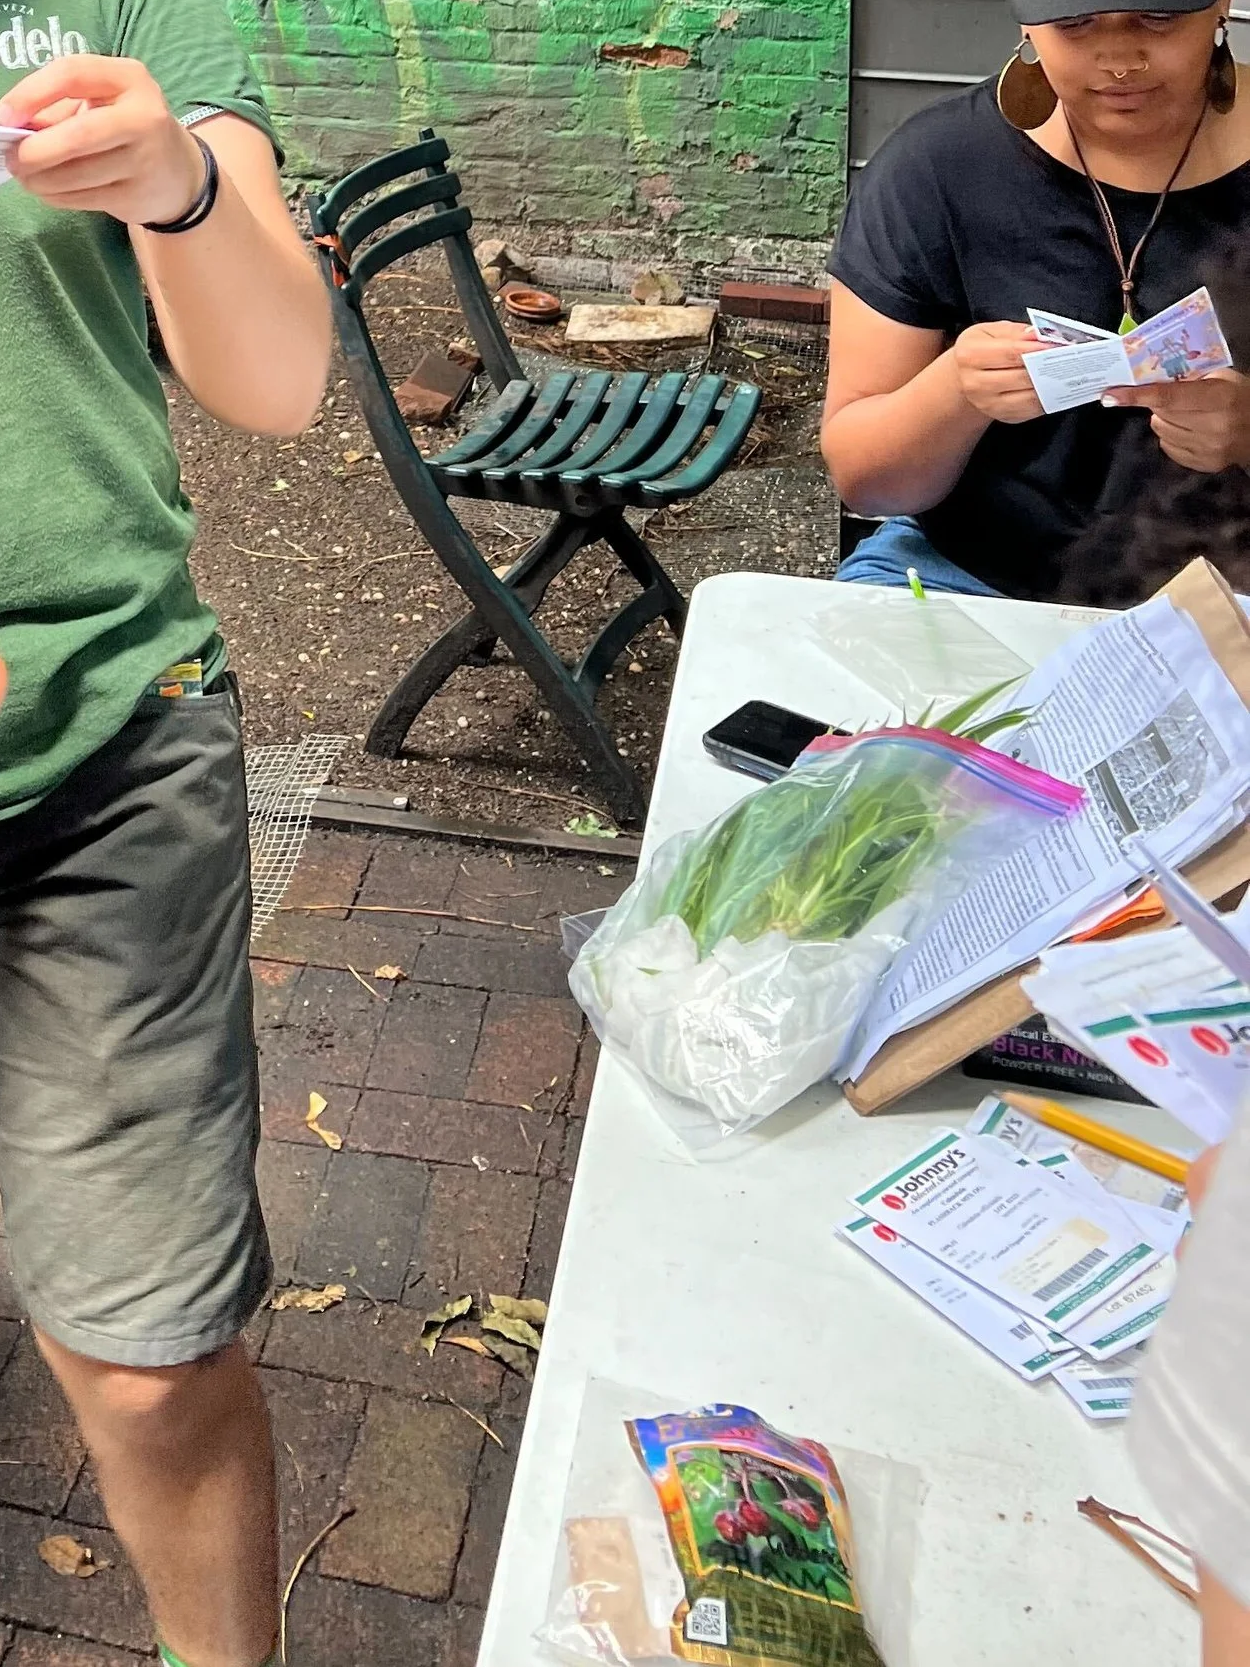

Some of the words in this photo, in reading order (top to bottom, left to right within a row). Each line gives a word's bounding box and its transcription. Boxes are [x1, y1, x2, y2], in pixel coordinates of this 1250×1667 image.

[993, 1036, 1054, 1062] Black
[992, 1055, 1042, 1072] POWDER
[1045, 1065, 1076, 1079] FREE
[895, 1149, 966, 1198] Johnny's
